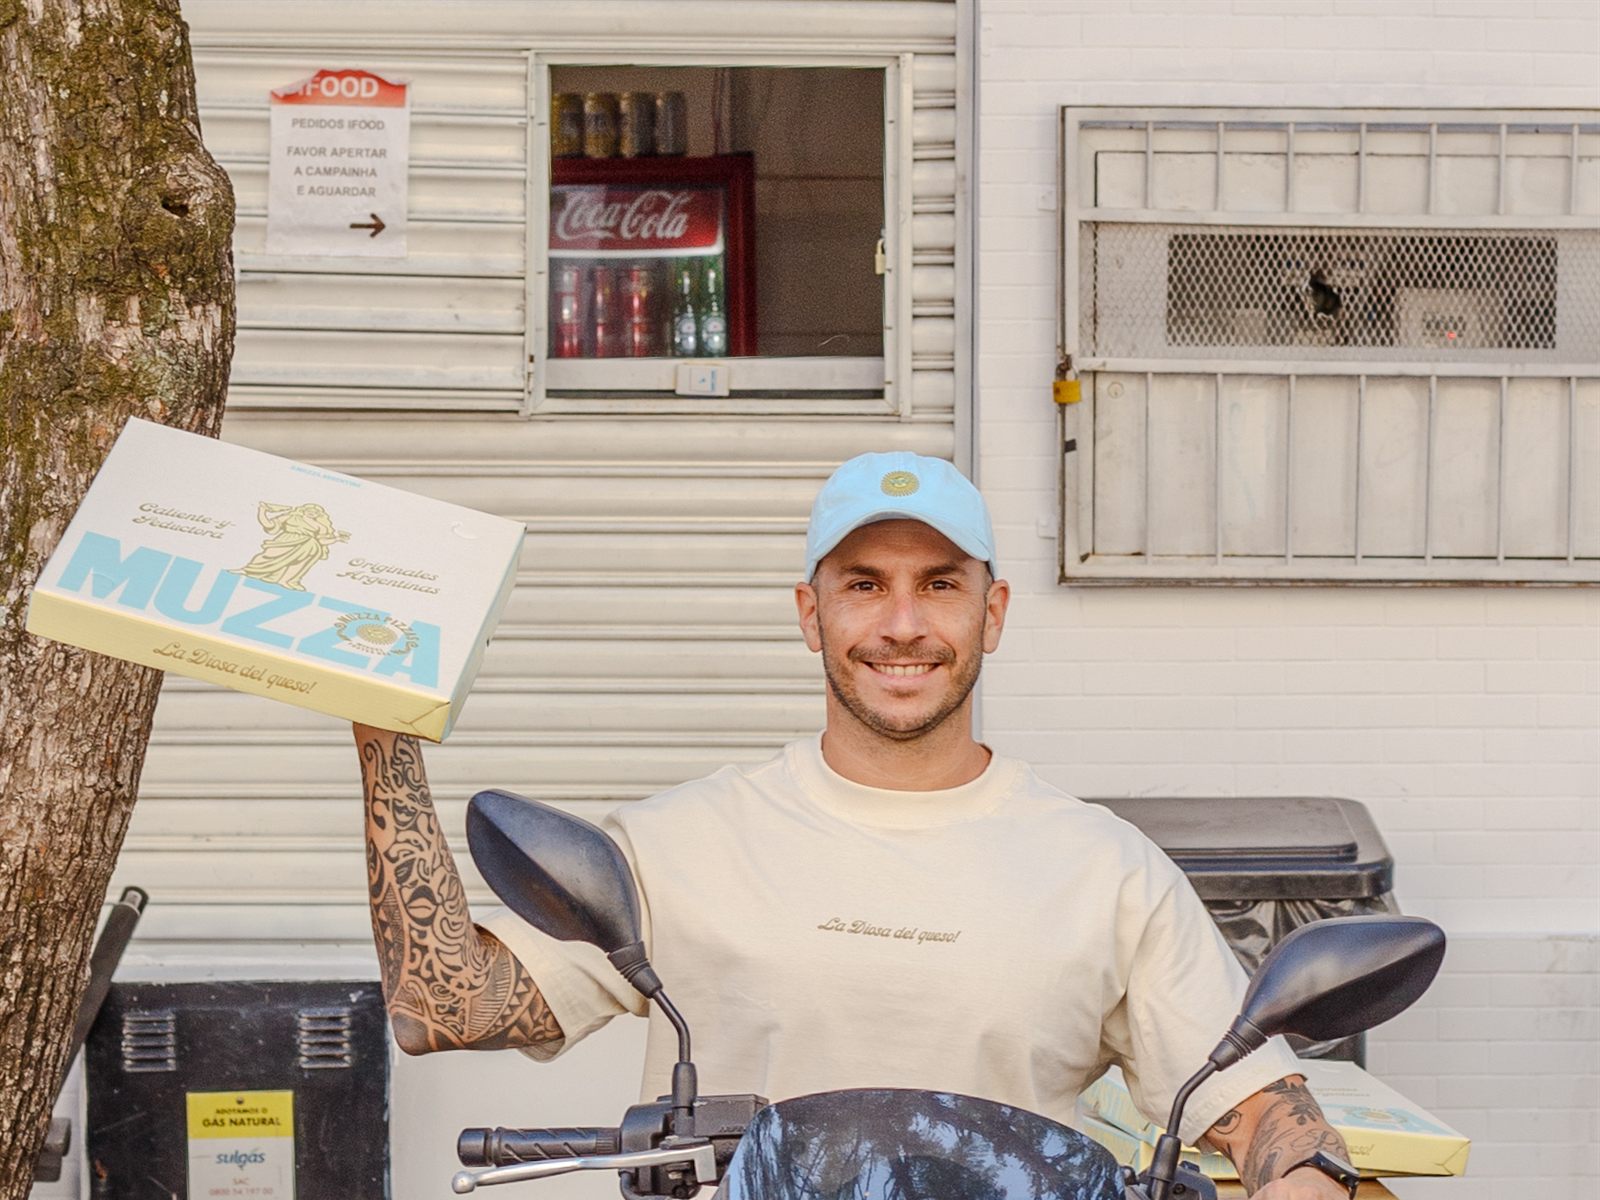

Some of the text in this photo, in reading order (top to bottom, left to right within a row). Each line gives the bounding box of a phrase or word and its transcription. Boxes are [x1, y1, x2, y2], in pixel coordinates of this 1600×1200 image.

[291, 118, 345, 129] PEDIDOS
[286, 146, 387, 158] FAVOR APERTAR
[294, 166, 378, 178] A CAMPAINHA
[296, 185, 376, 197] E AGUARDAR
[348, 558, 439, 581] Originales
[336, 571, 440, 594] Argentinas
[56, 531, 441, 689] MUZZA
[153, 642, 317, 694] La Diosa del queso!
[817, 917, 961, 945] La Diosa del queso!
[229, 1117, 281, 1127] NATURAL
